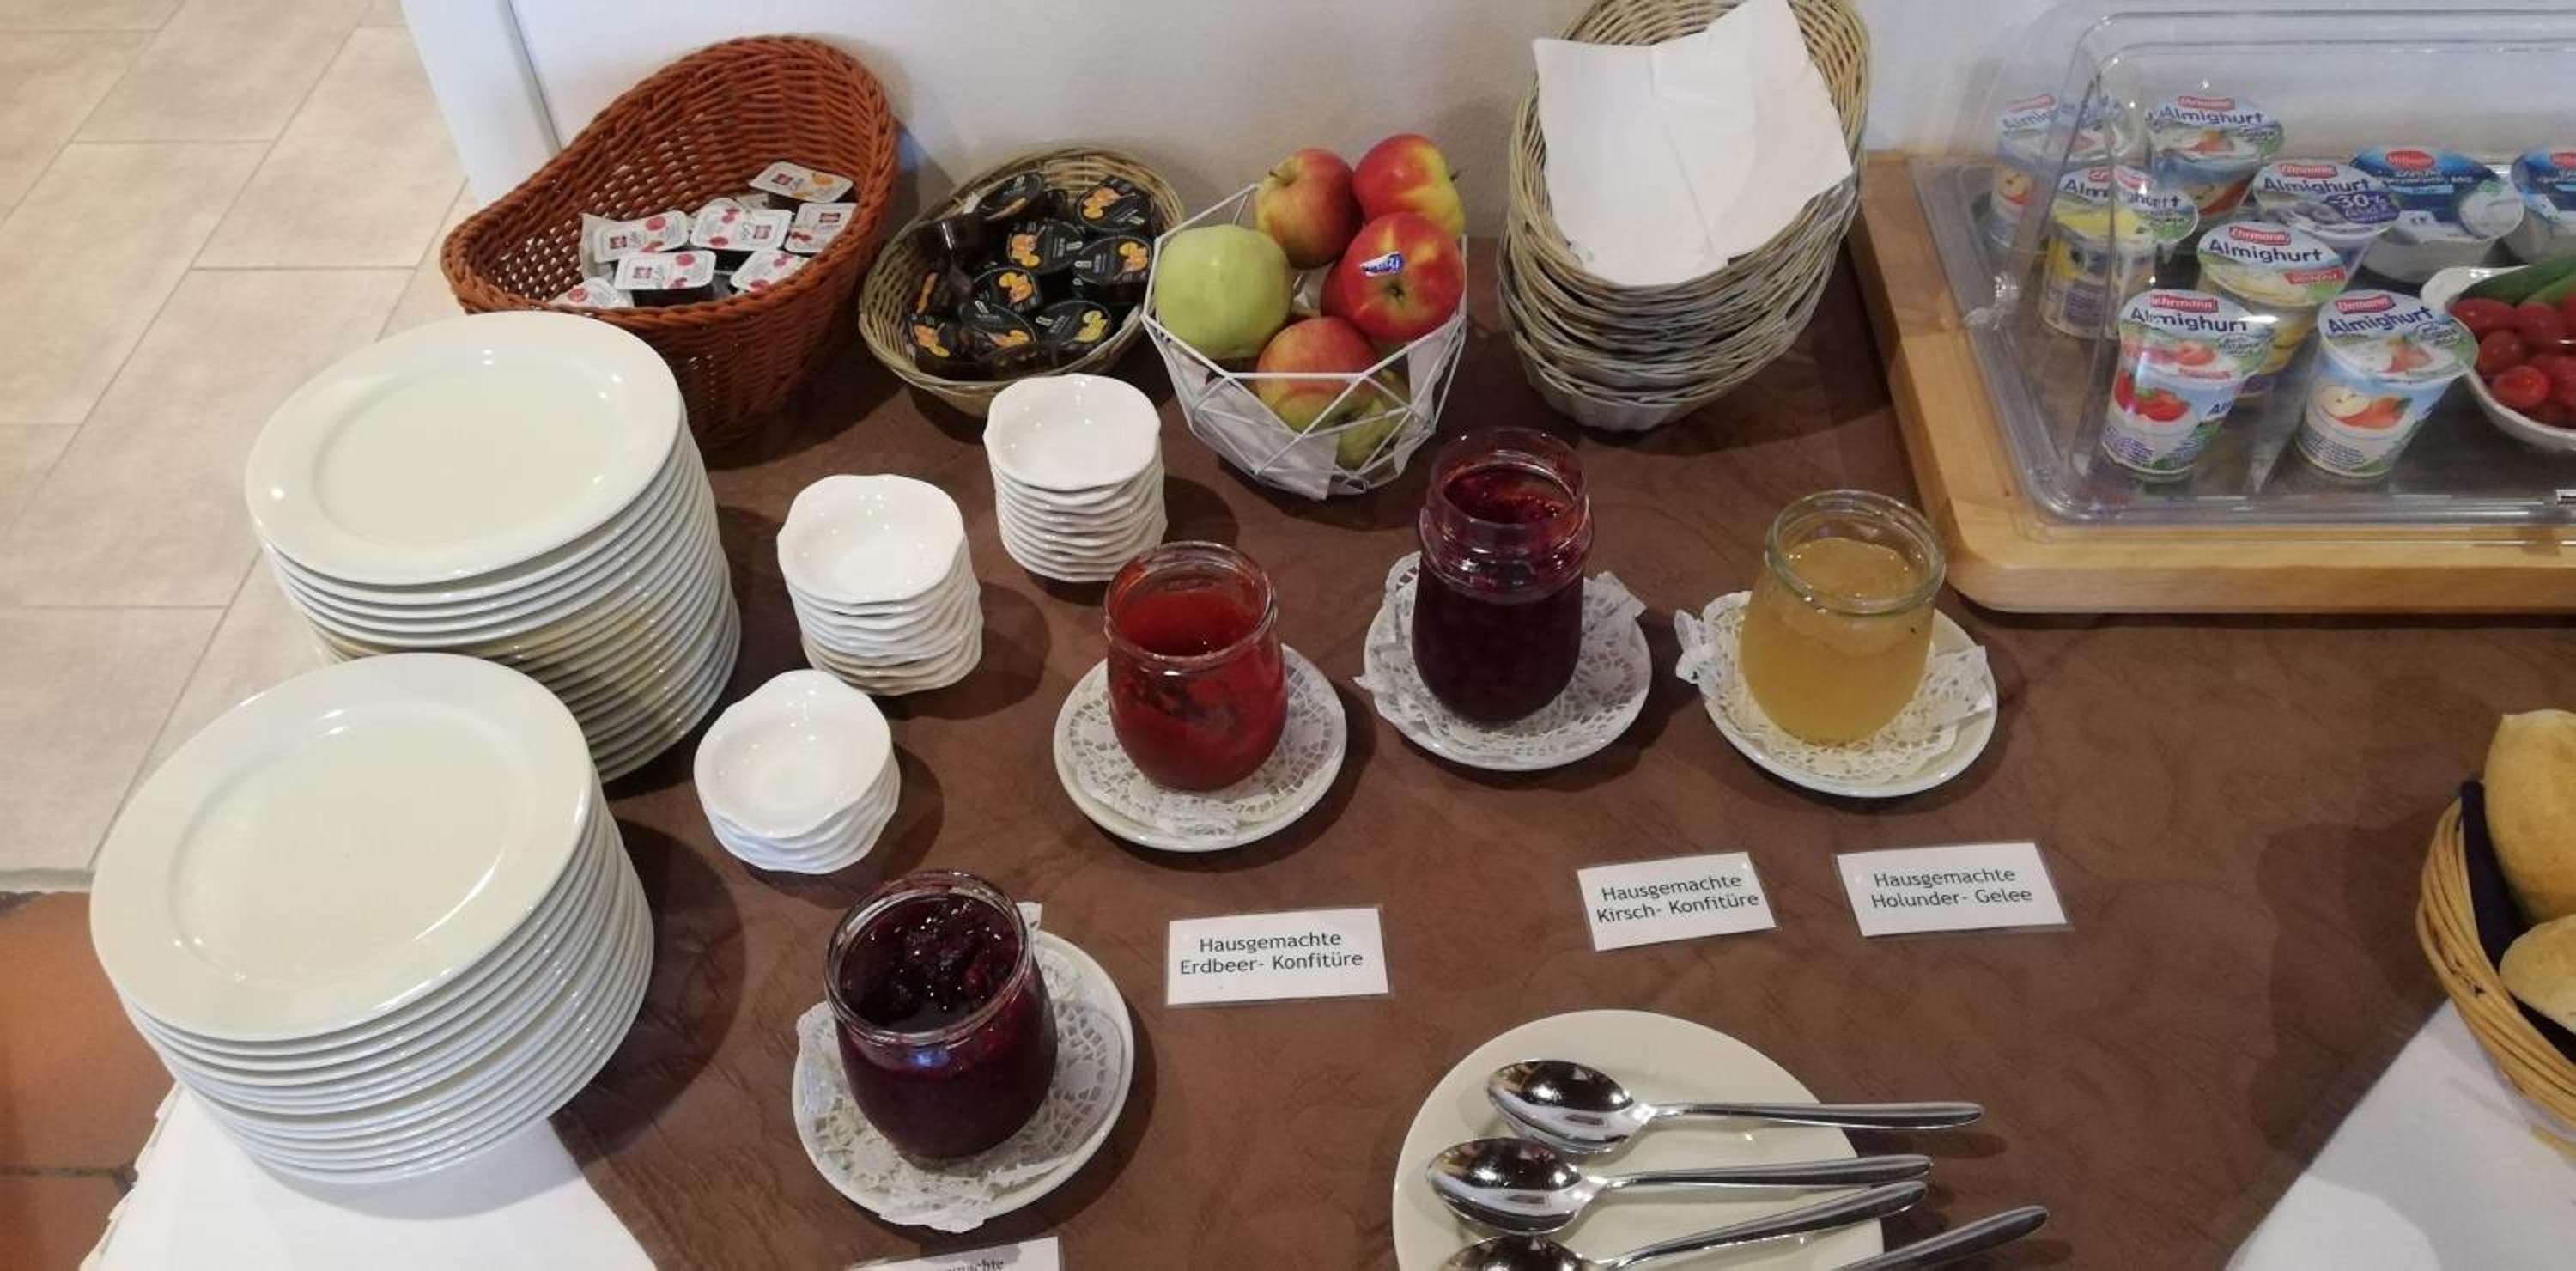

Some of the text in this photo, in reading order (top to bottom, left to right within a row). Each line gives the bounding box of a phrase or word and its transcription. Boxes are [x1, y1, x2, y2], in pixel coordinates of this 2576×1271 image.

[2162, 106, 2264, 125] Almighurt
[2263, 178, 2370, 194] Almighurt
[2209, 239, 2323, 264] Almighurt
[2327, 306, 2433, 334] Almighurt
[1601, 875, 1743, 902] Hausgemachte
[1873, 868, 2017, 888] Hausgemachte
[1596, 893, 1759, 923] Kirsch- Konfitüre
[1870, 888, 2033, 908] Holunder- Gelee
[1200, 932, 1342, 953] Hausgemachte
[1180, 952, 1364, 975] Erdbeer- Konfitüre
